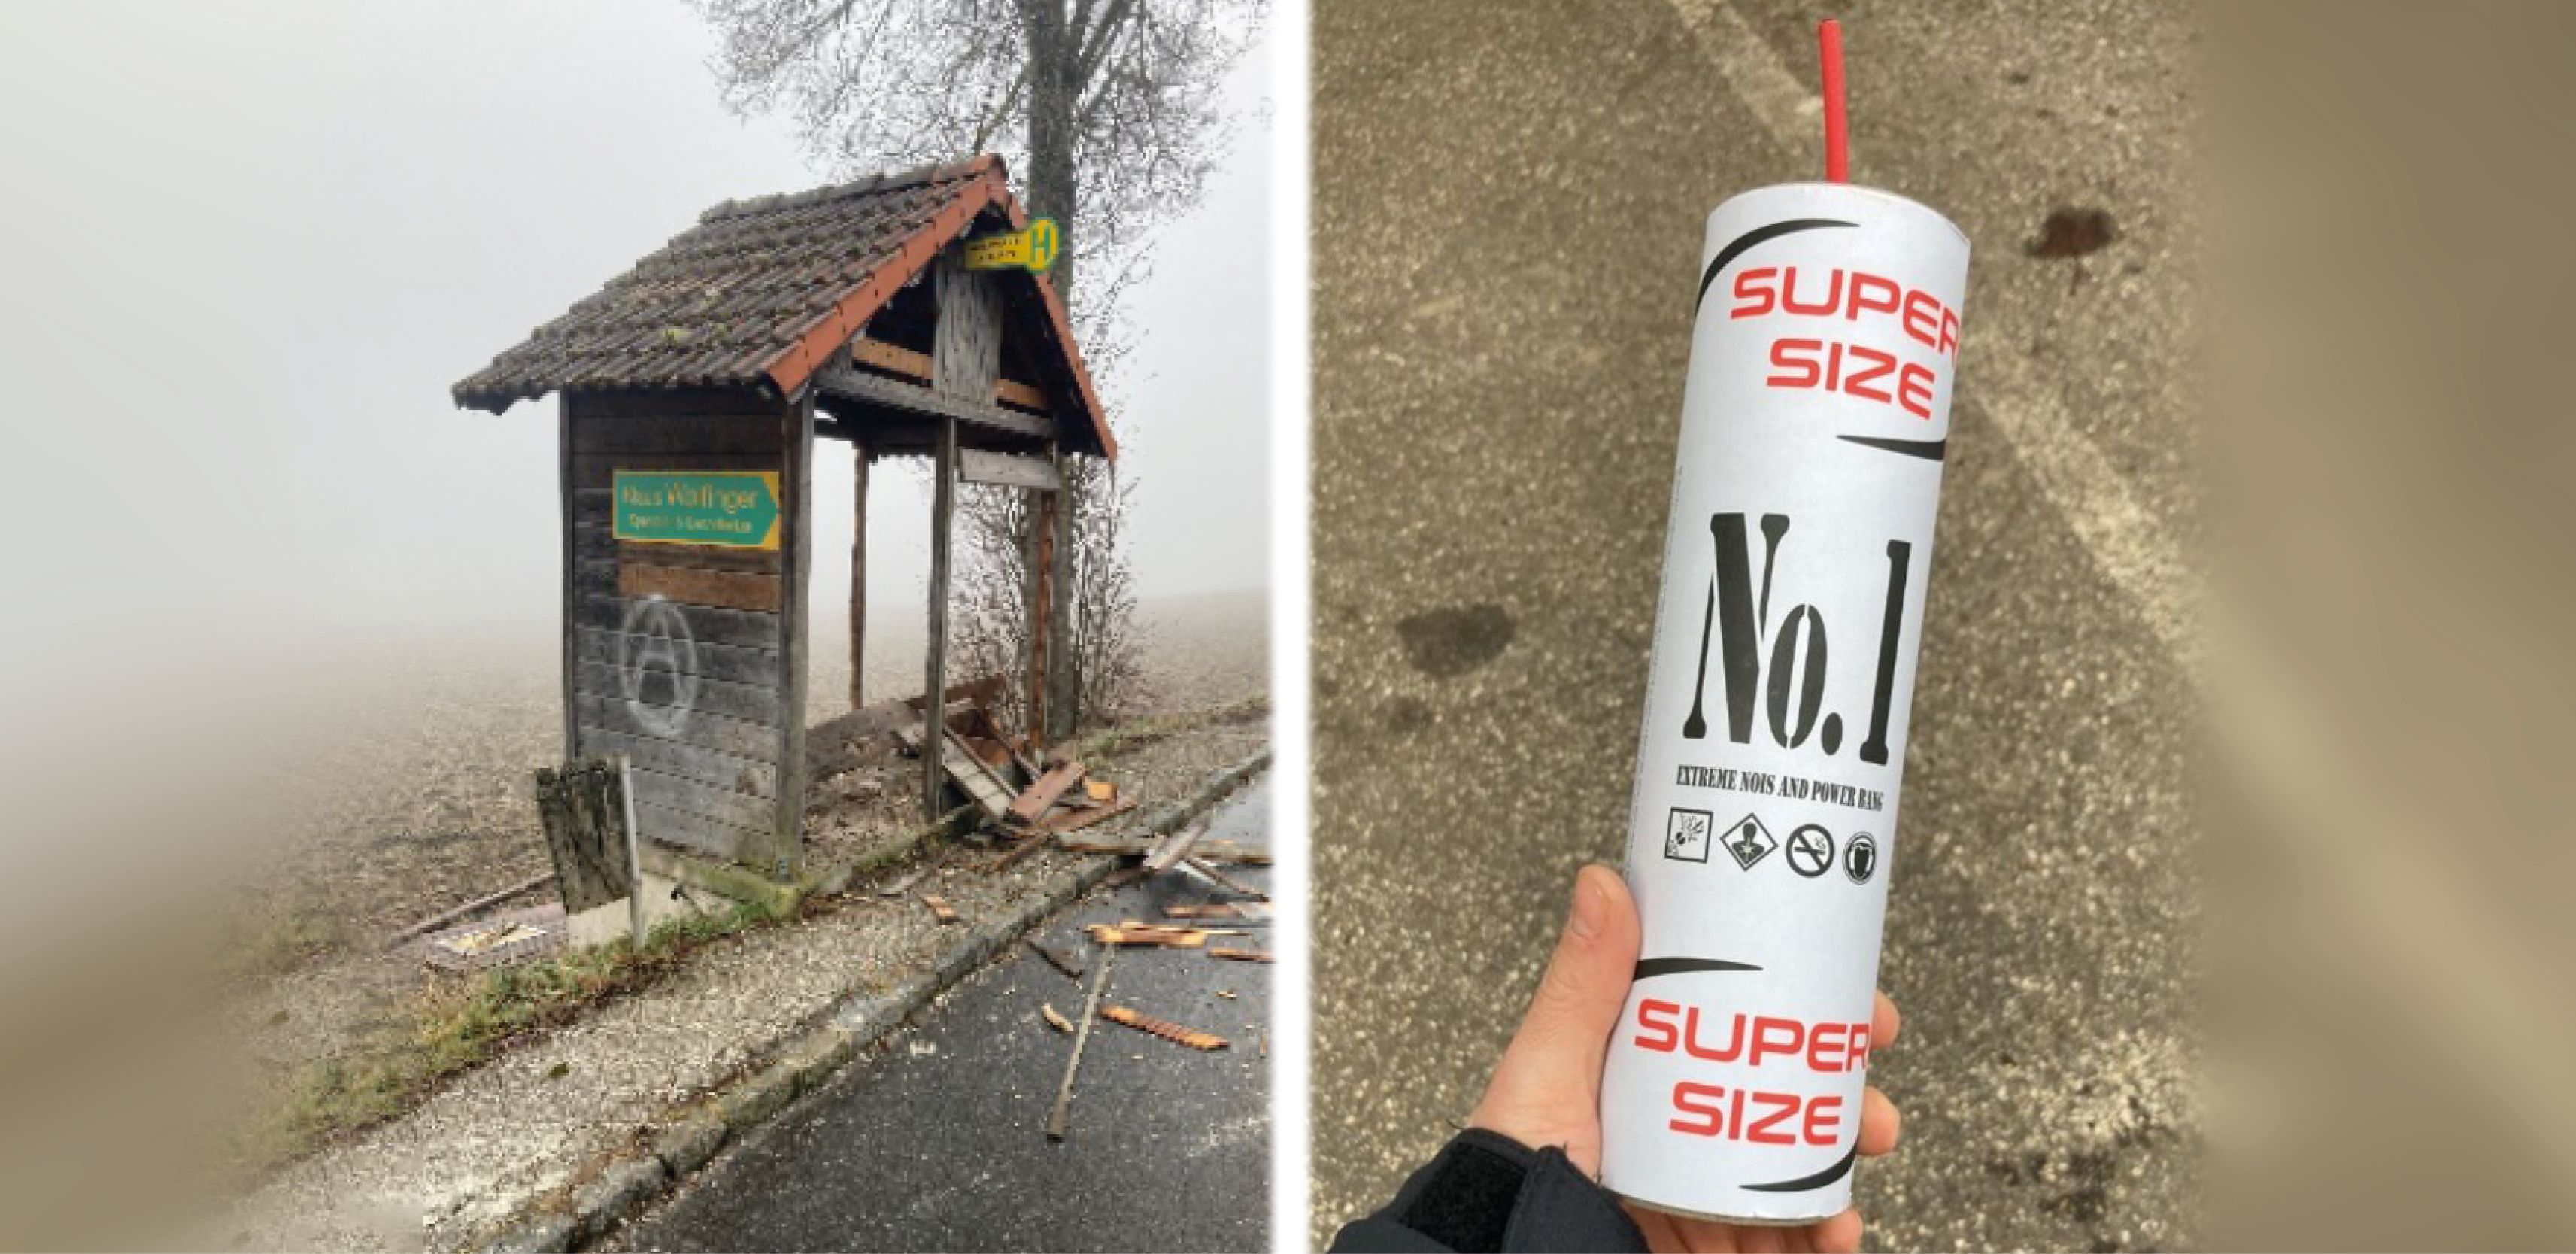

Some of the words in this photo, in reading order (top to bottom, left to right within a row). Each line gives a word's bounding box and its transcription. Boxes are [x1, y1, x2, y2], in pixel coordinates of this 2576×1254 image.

[1032, 227, 1051, 263] H
[1730, 266, 1961, 369] SUPER
[1767, 338, 1935, 421] SIZE
[1676, 764, 1737, 791] EXTREME
[1739, 771, 1776, 796] NOIS
[1777, 776, 1809, 800] AND
[1810, 779, 1857, 808] POWER
[1858, 788, 1884, 812] BANG
[1634, 998, 1871, 1073] SUPER
[1669, 1081, 1842, 1145] SIZE
